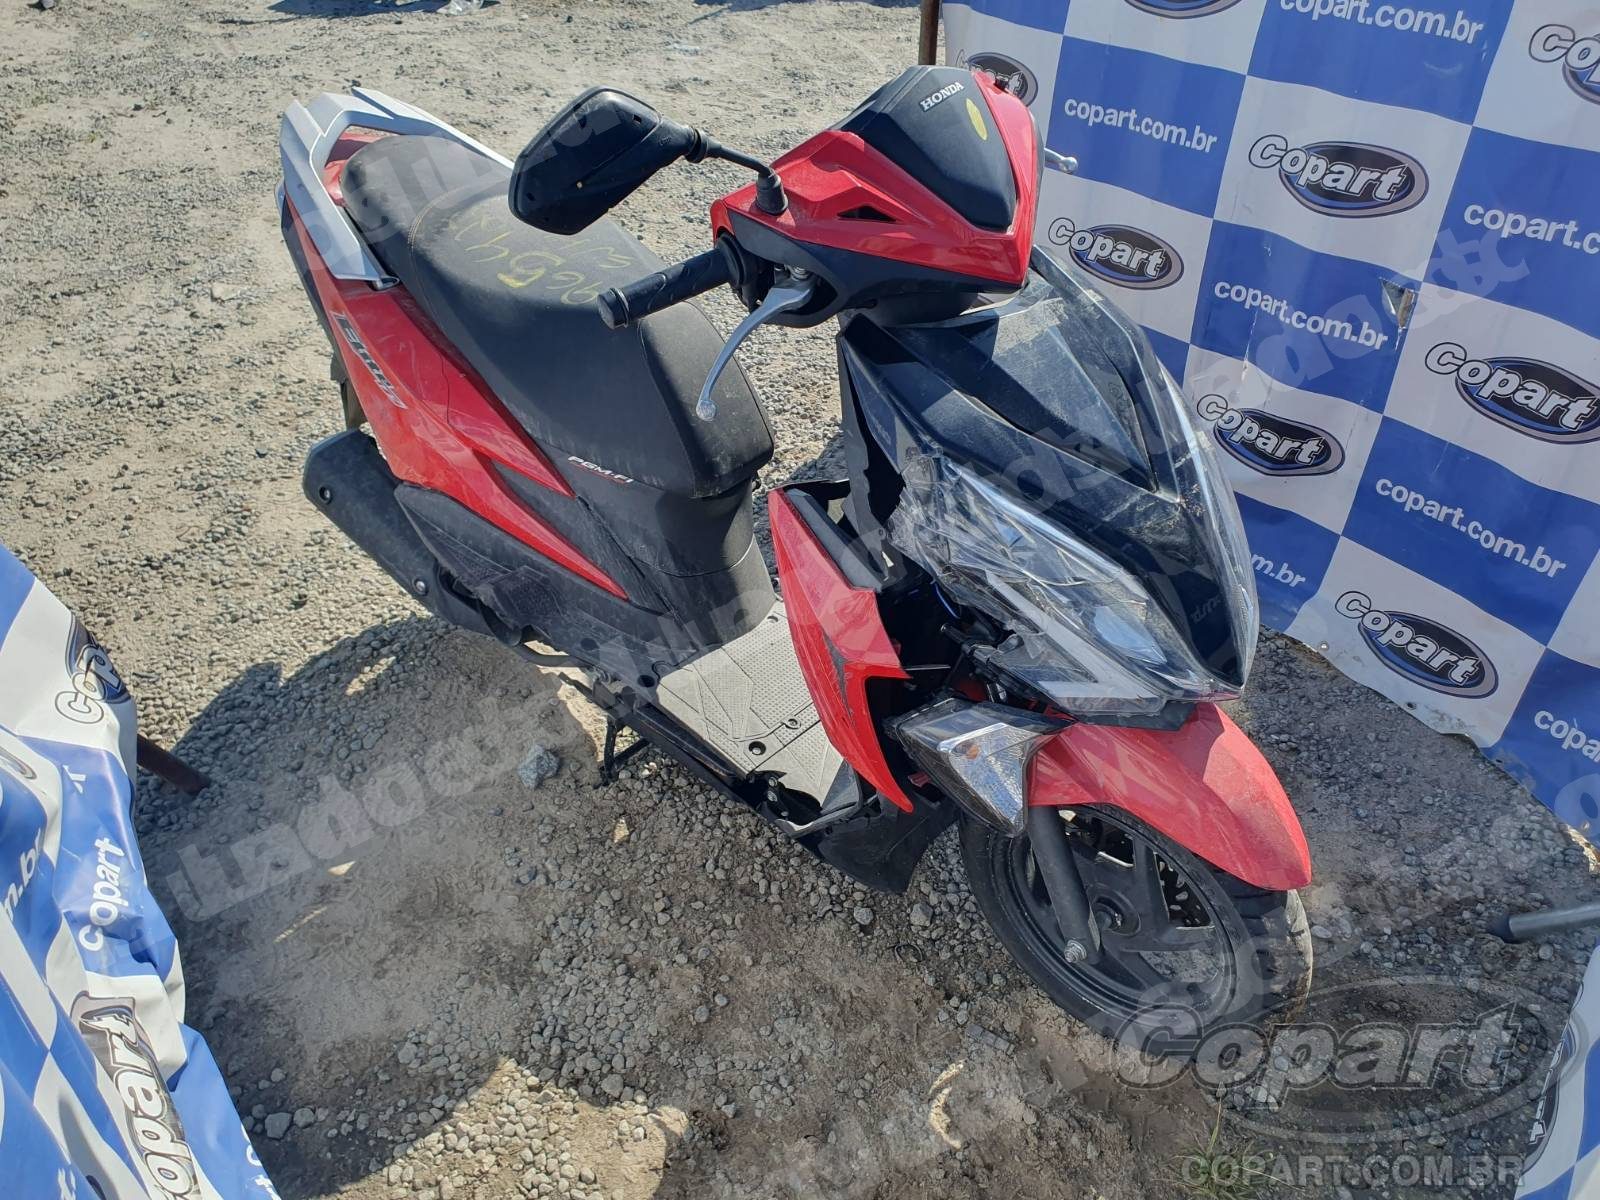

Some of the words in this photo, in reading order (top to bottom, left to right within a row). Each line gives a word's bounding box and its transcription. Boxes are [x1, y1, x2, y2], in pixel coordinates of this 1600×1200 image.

[919, 81, 966, 112] HONDA
[1063, 98, 1218, 153] copart.com.br
[1248, 134, 1409, 201] Copart
[1048, 217, 1166, 279] Copart
[1214, 281, 1389, 350] copart.com.br
[1425, 342, 1599, 430] Copart
[1196, 393, 1326, 466] Copart
[1375, 478, 1567, 578] copart.com.br
[1335, 590, 1480, 686] Copart
